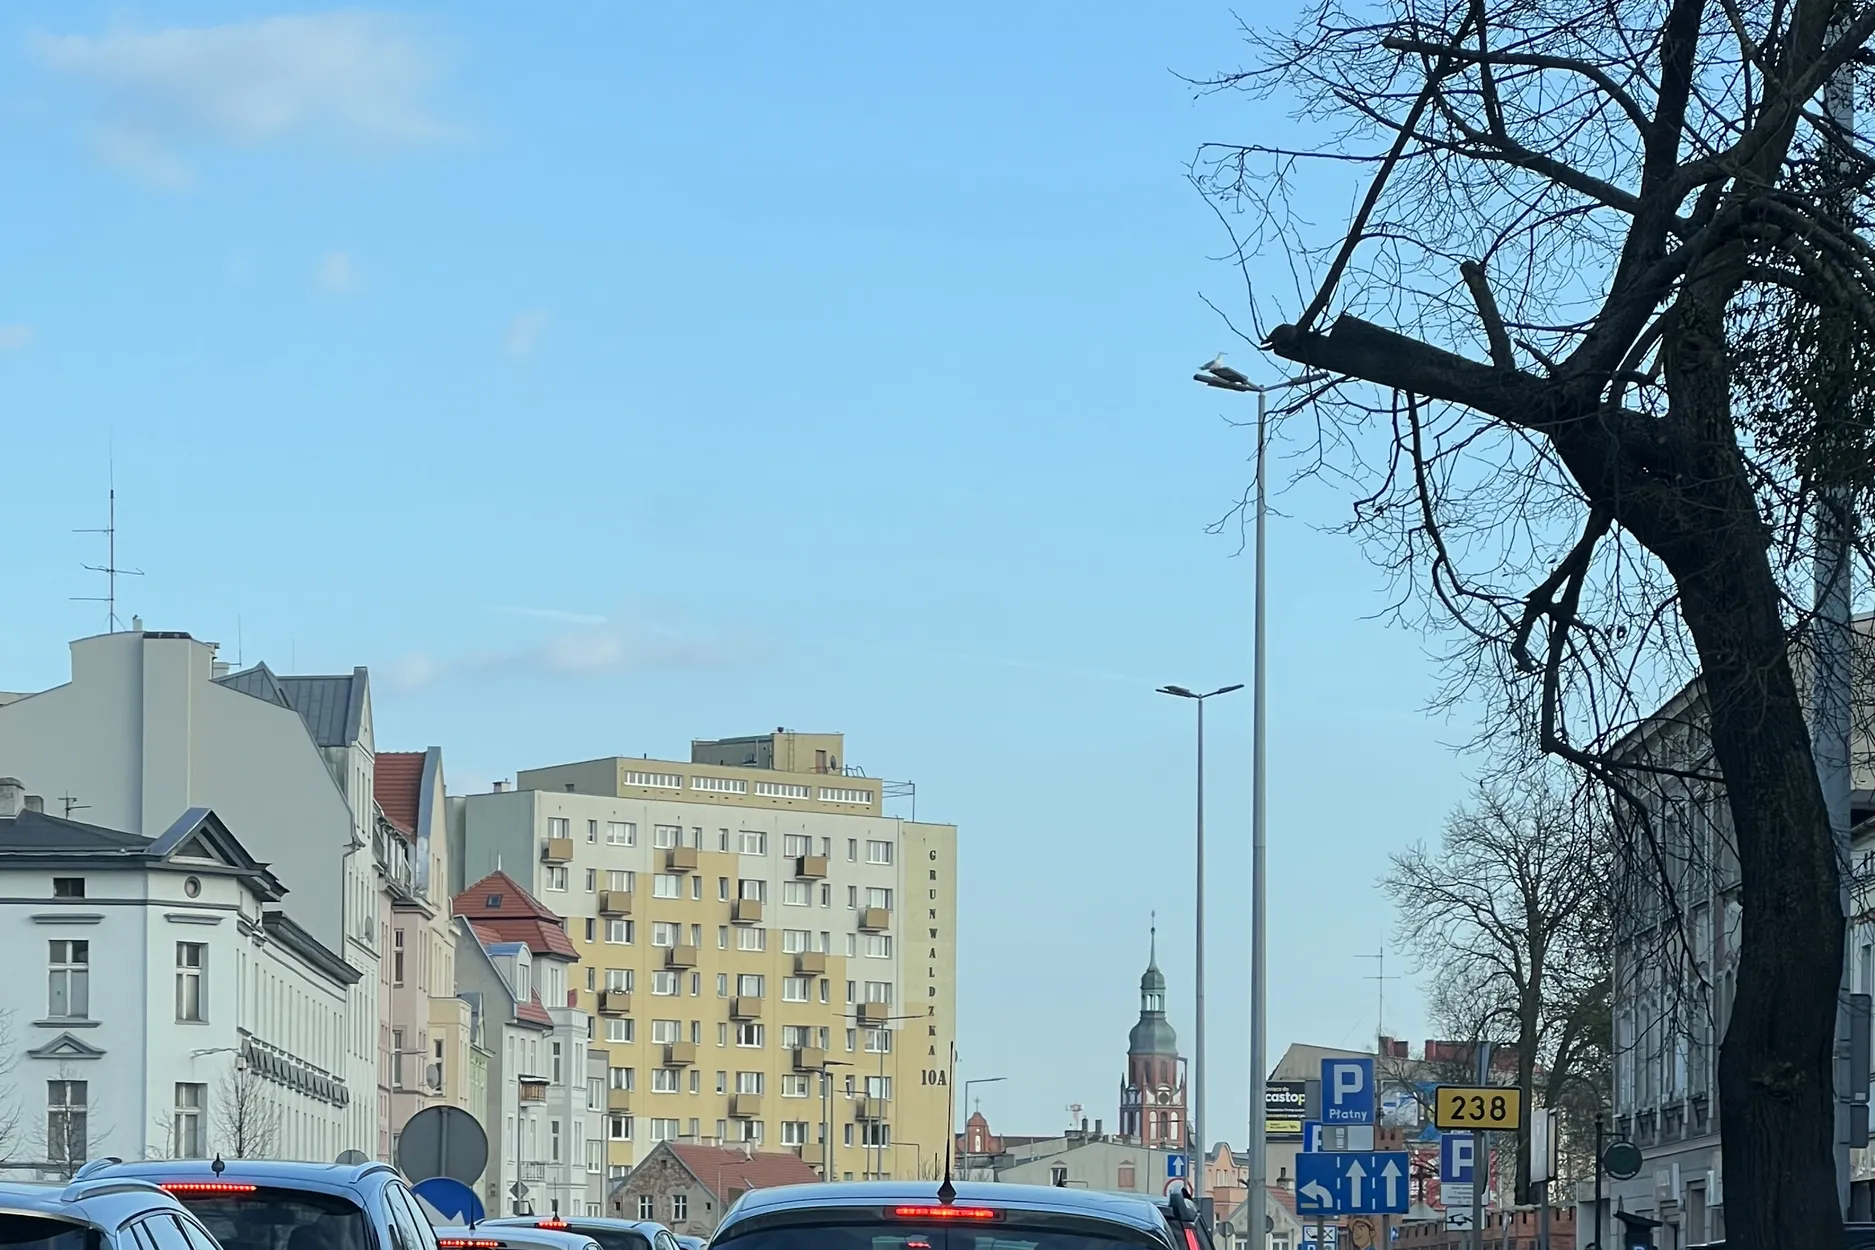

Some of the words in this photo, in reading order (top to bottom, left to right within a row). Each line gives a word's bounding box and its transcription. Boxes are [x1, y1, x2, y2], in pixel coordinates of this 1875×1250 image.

[928, 849, 938, 1056] GRUNWALDZKA
[921, 1069, 947, 1086] 10A
[1333, 1064, 1364, 1105] P
[1329, 1108, 1368, 1121] Płatny
[1451, 1095, 1506, 1121] 238
[1452, 1139, 1474, 1178] P
